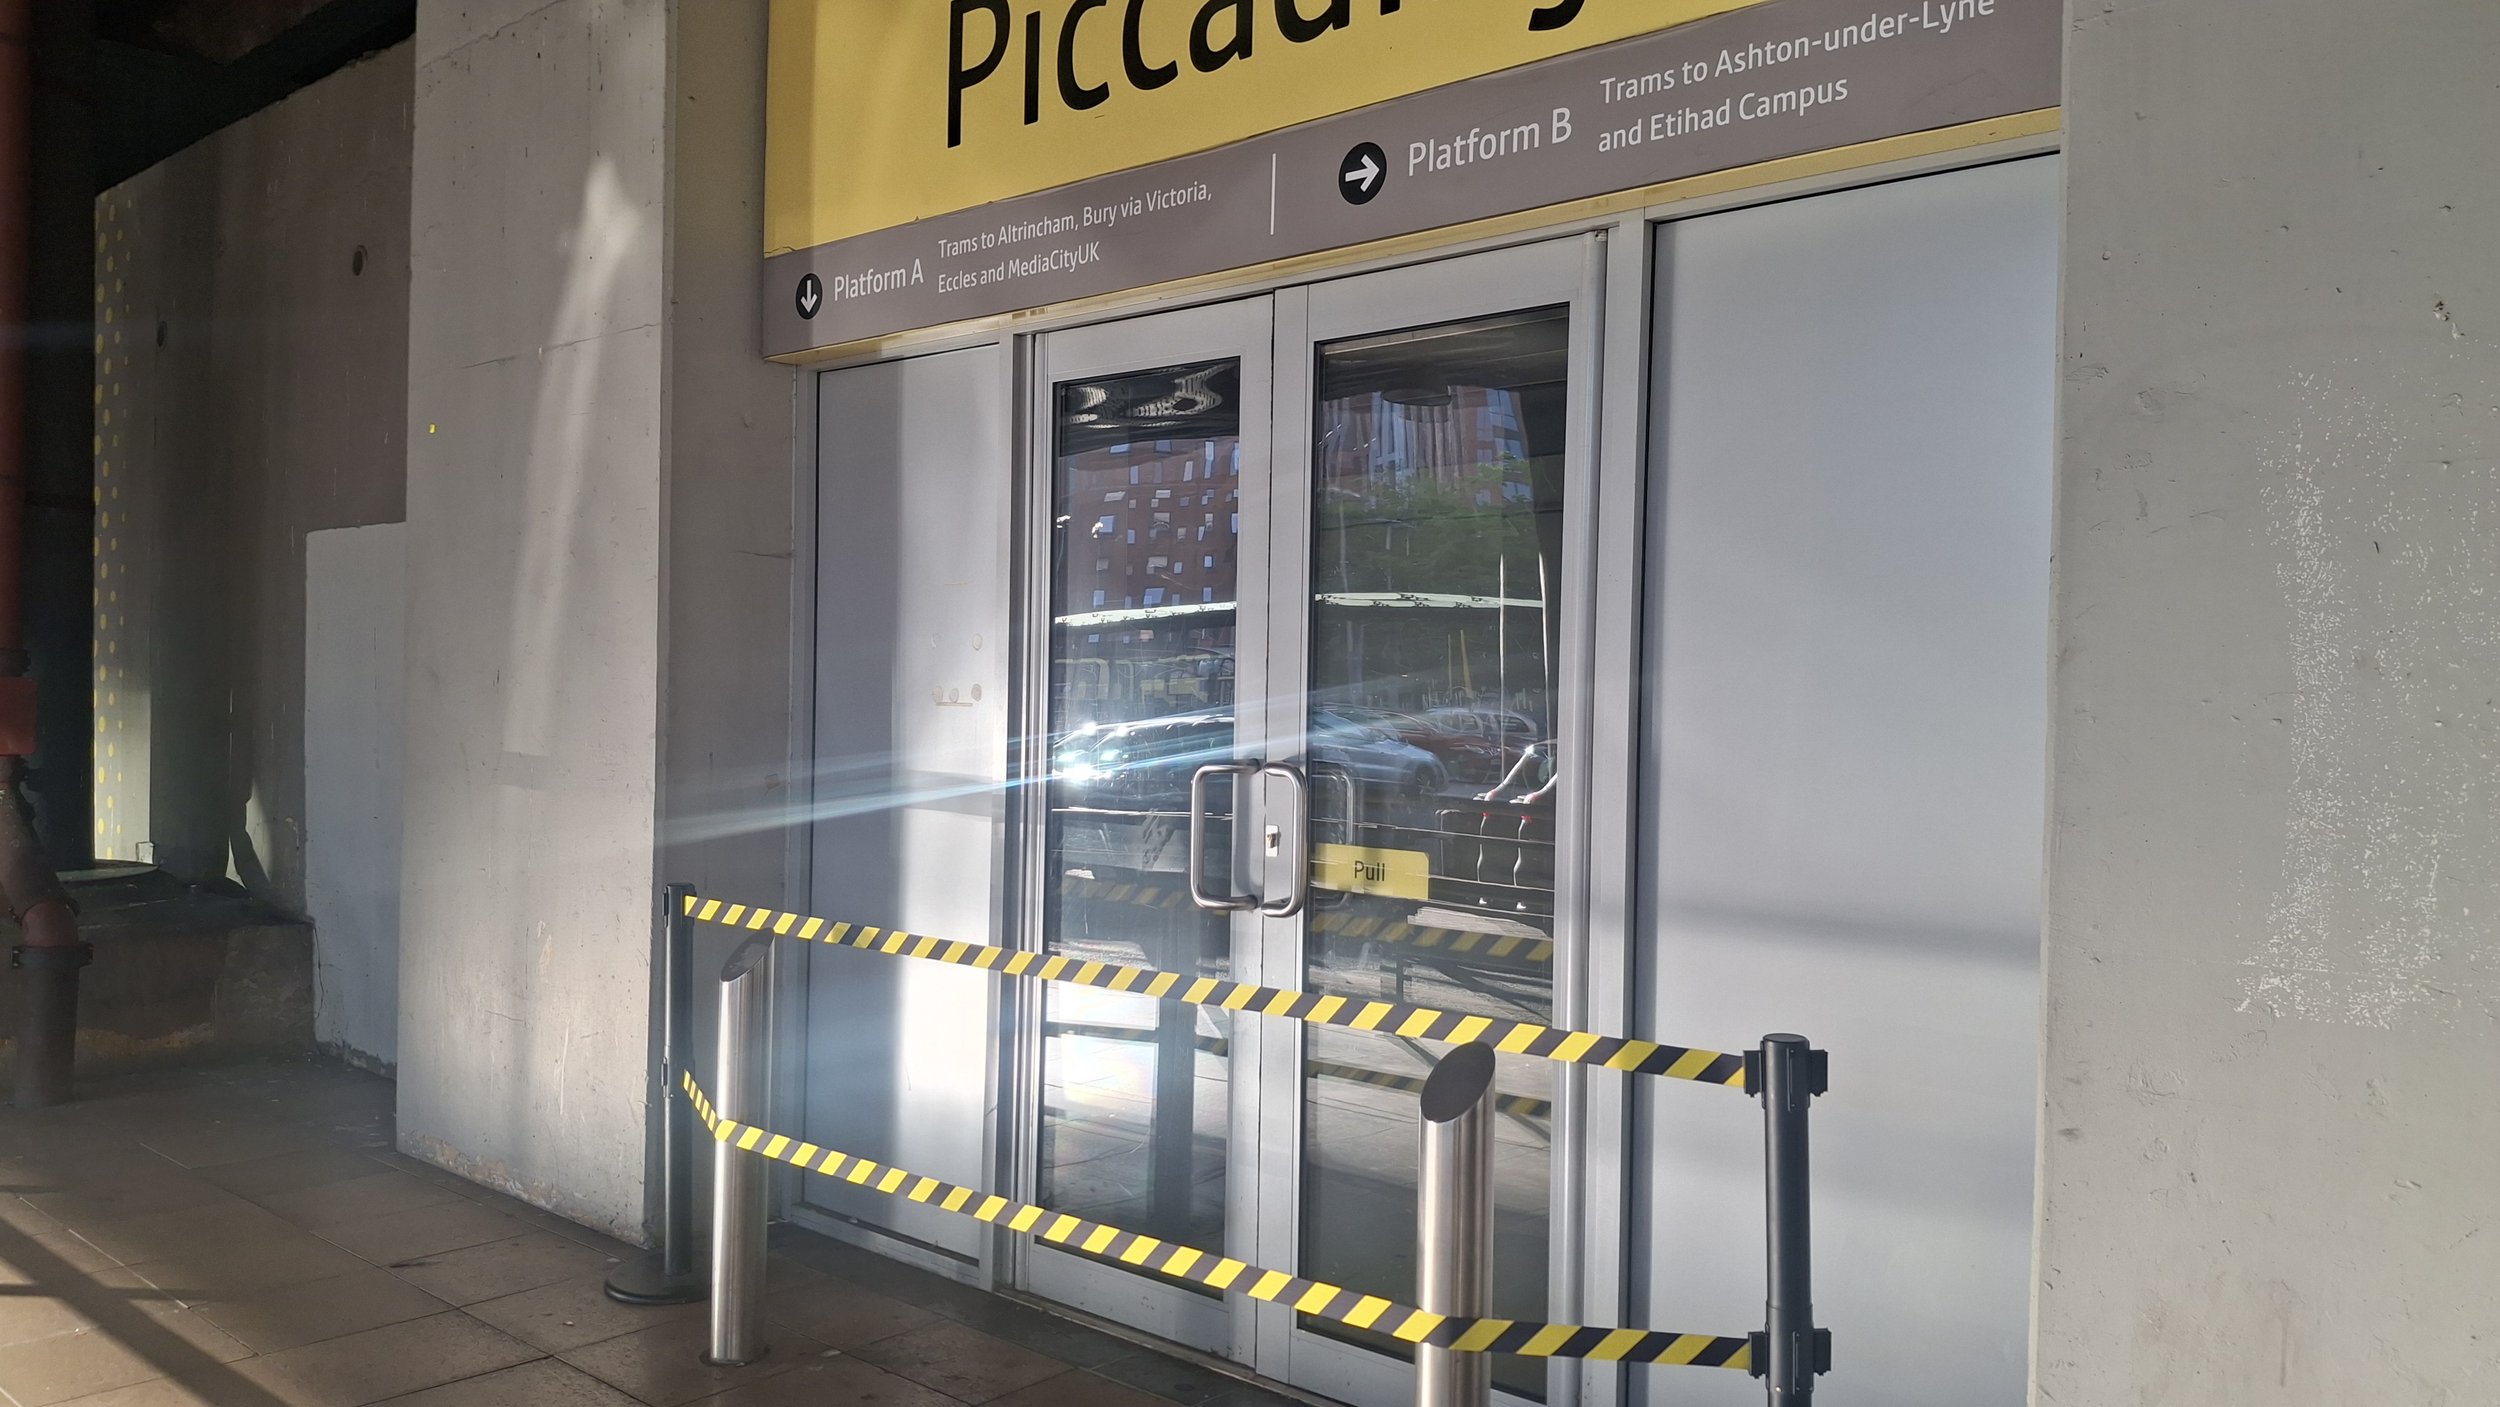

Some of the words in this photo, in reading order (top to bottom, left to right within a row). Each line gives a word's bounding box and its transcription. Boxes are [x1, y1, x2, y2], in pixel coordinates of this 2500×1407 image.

[947, 0, 1588, 149] Picca
[1600, 68, 1675, 104] Trams
[1683, 61, 1708, 85] to
[1408, 122, 1540, 177] Platform
[1551, 107, 1572, 144] B
[1598, 118, 1642, 152] and
[1650, 98, 1730, 141] Etihad
[1738, 78, 1848, 117] Campus
[938, 235, 977, 258] Trams
[981, 231, 995, 250] to
[997, 214, 1078, 246] Altrincham,
[1083, 205, 1118, 229] Bury
[1120, 197, 1142, 218] via
[1146, 181, 1212, 212] Victoria,
[834, 267, 906, 302] Platform
[911, 257, 924, 285] A
[938, 271, 977, 294] Eccles
[980, 262, 1004, 285] and
[1008, 240, 1100, 280] MediaCityUK
[1354, 860, 1385, 881] Pull
